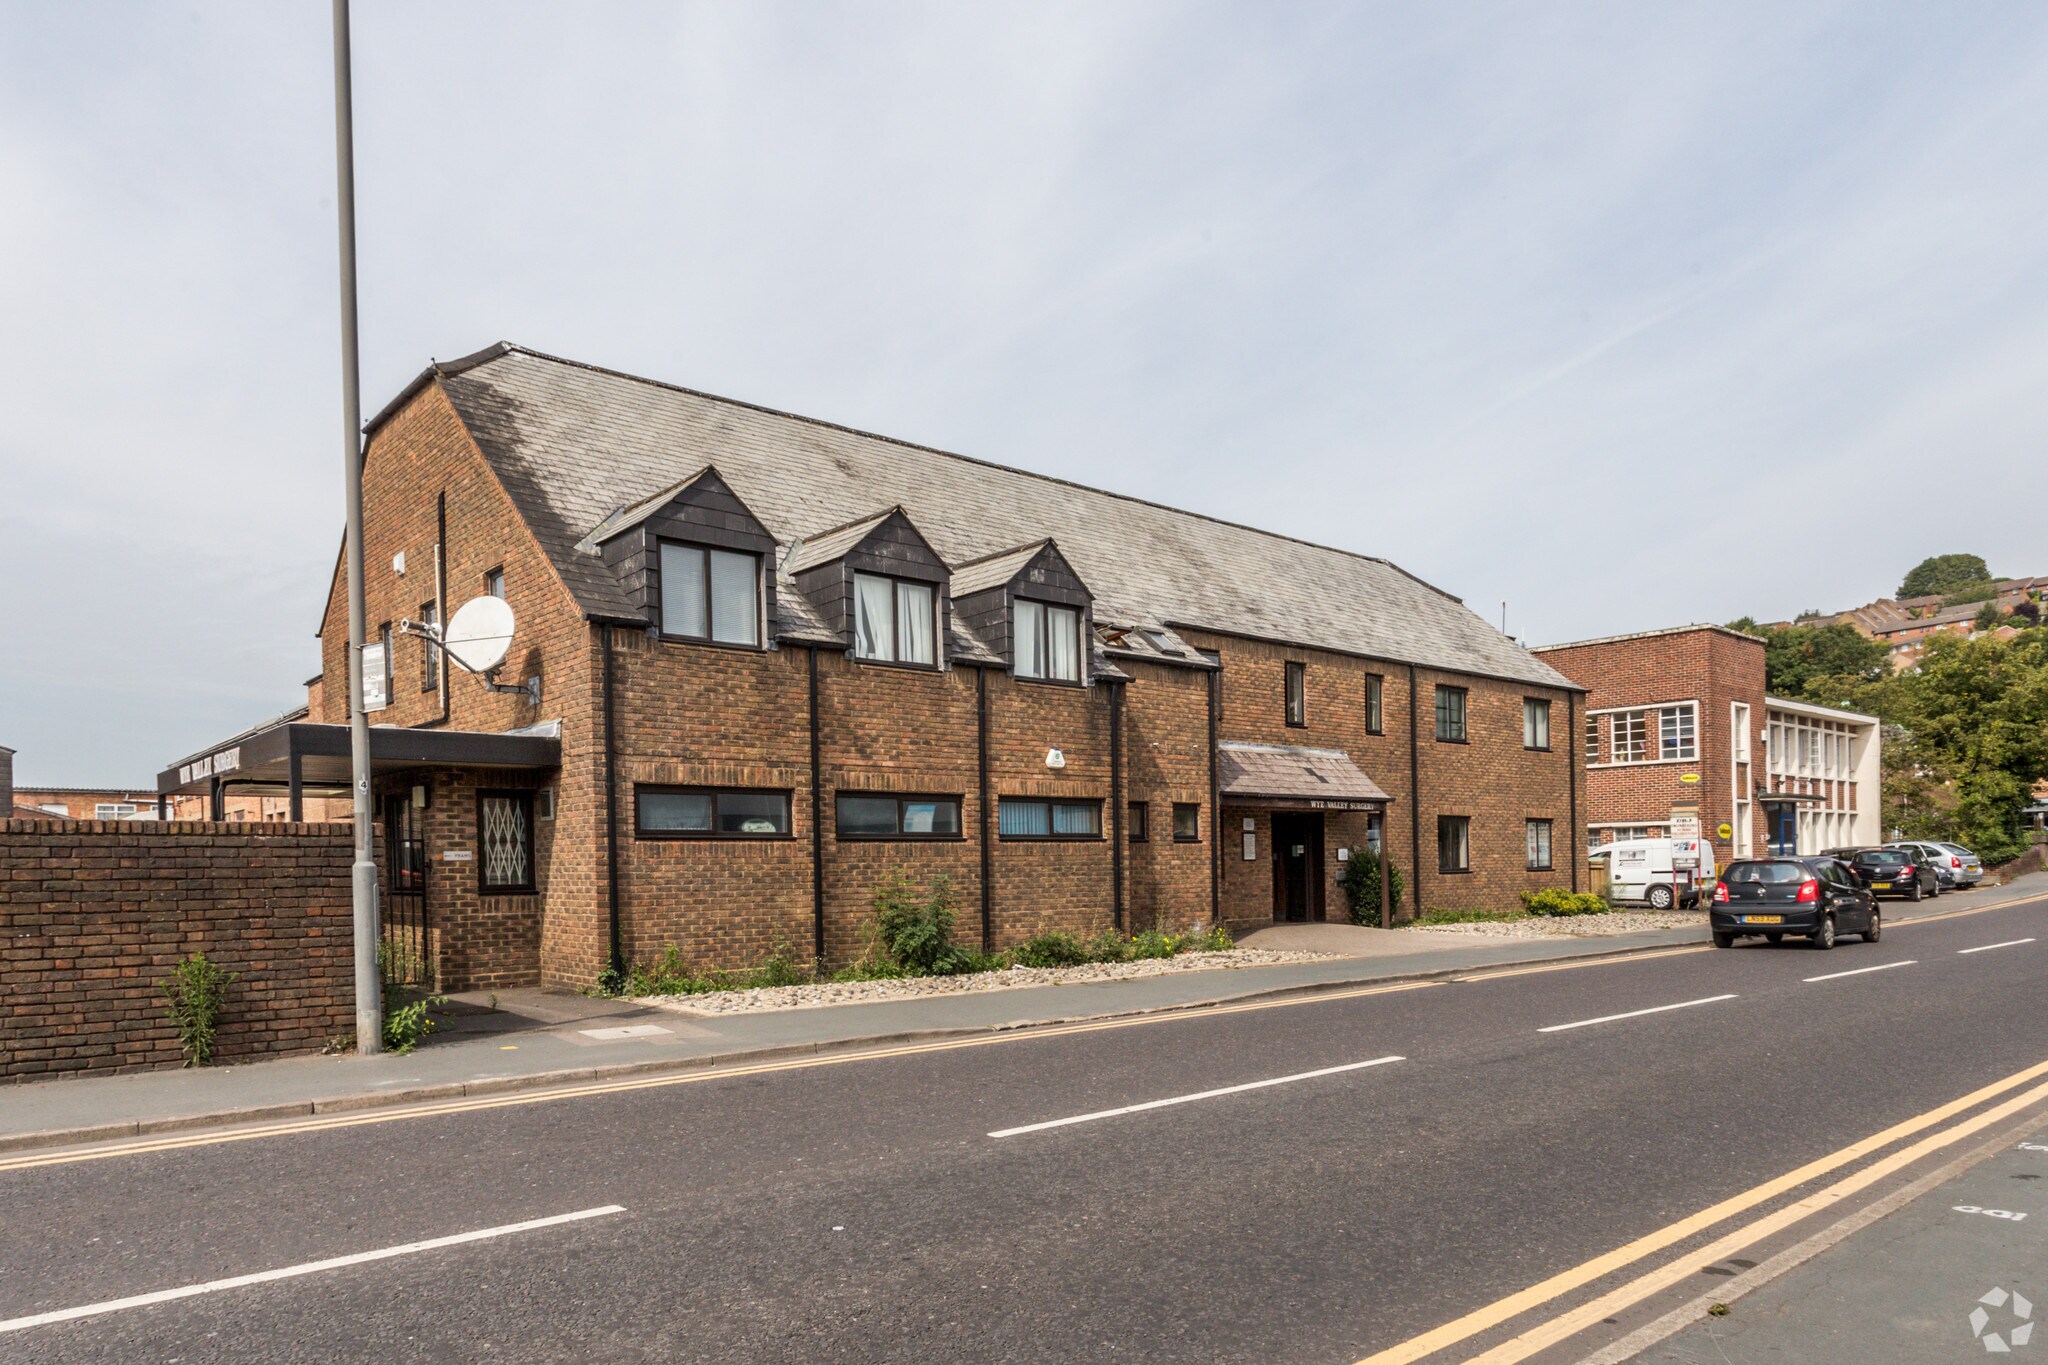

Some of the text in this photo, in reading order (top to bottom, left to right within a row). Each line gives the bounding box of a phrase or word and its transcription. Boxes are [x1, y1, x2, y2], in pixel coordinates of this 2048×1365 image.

[191, 756, 212, 781] VALLEY
[213, 746, 240, 774] SURGERY
[1310, 800, 1374, 810] WYE VALLEY SURGERY
